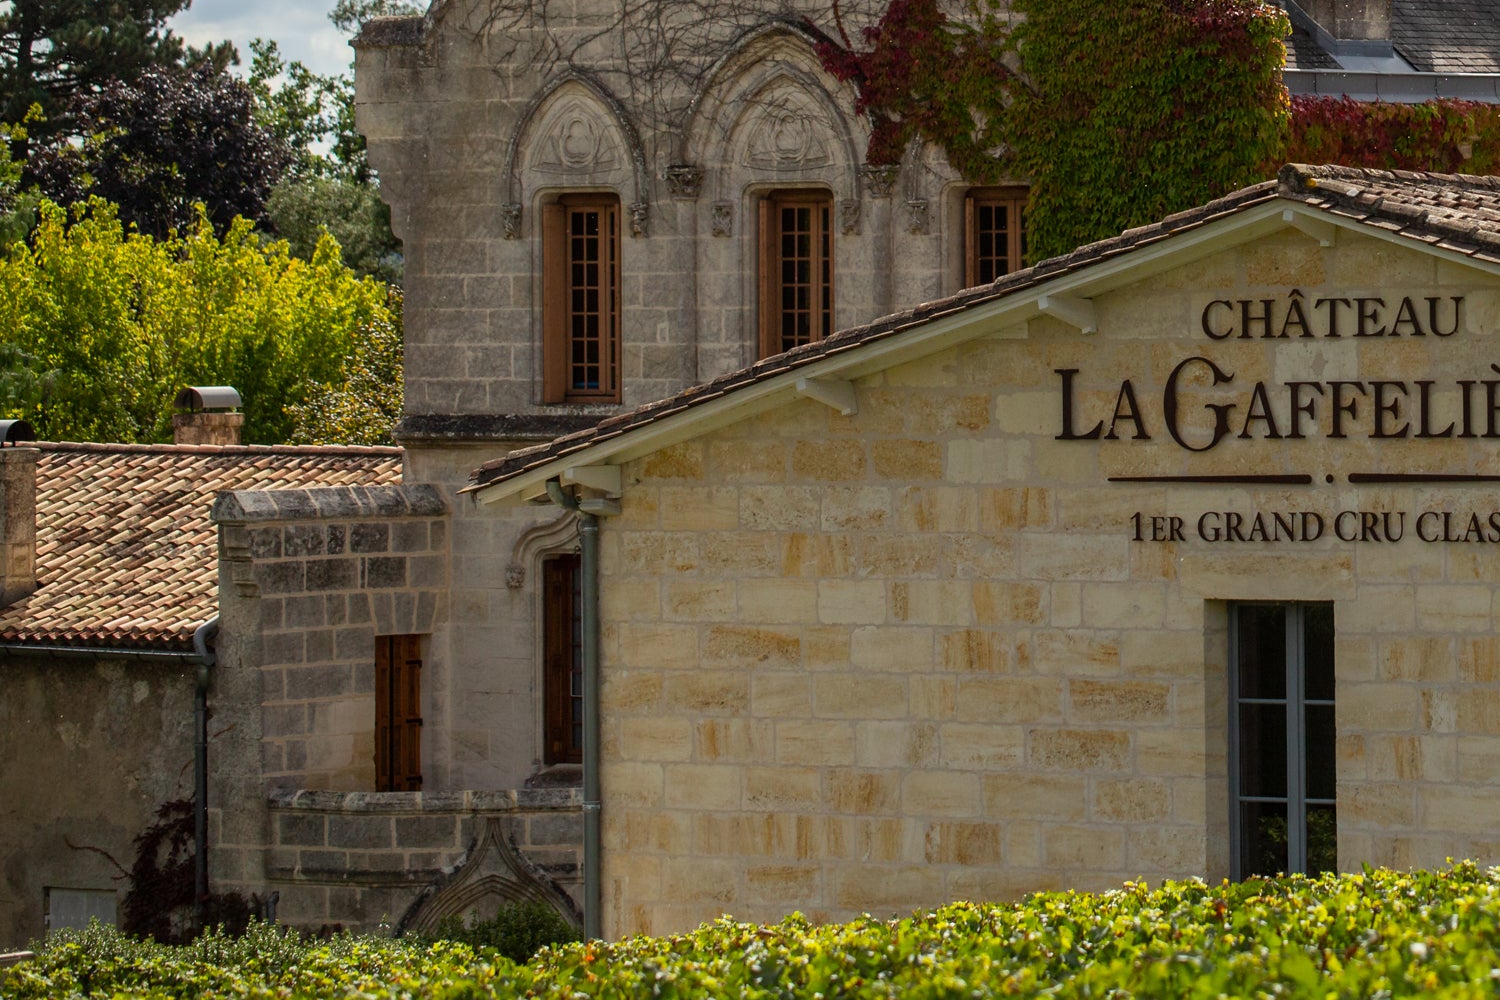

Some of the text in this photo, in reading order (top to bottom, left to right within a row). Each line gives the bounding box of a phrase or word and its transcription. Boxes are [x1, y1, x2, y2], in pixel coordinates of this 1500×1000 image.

[1201, 288, 1466, 342] CHÂTEAU
[1130, 511, 1187, 543] 1ER
[1197, 511, 1326, 543] GRAND
[1333, 510, 1406, 543] CRU
